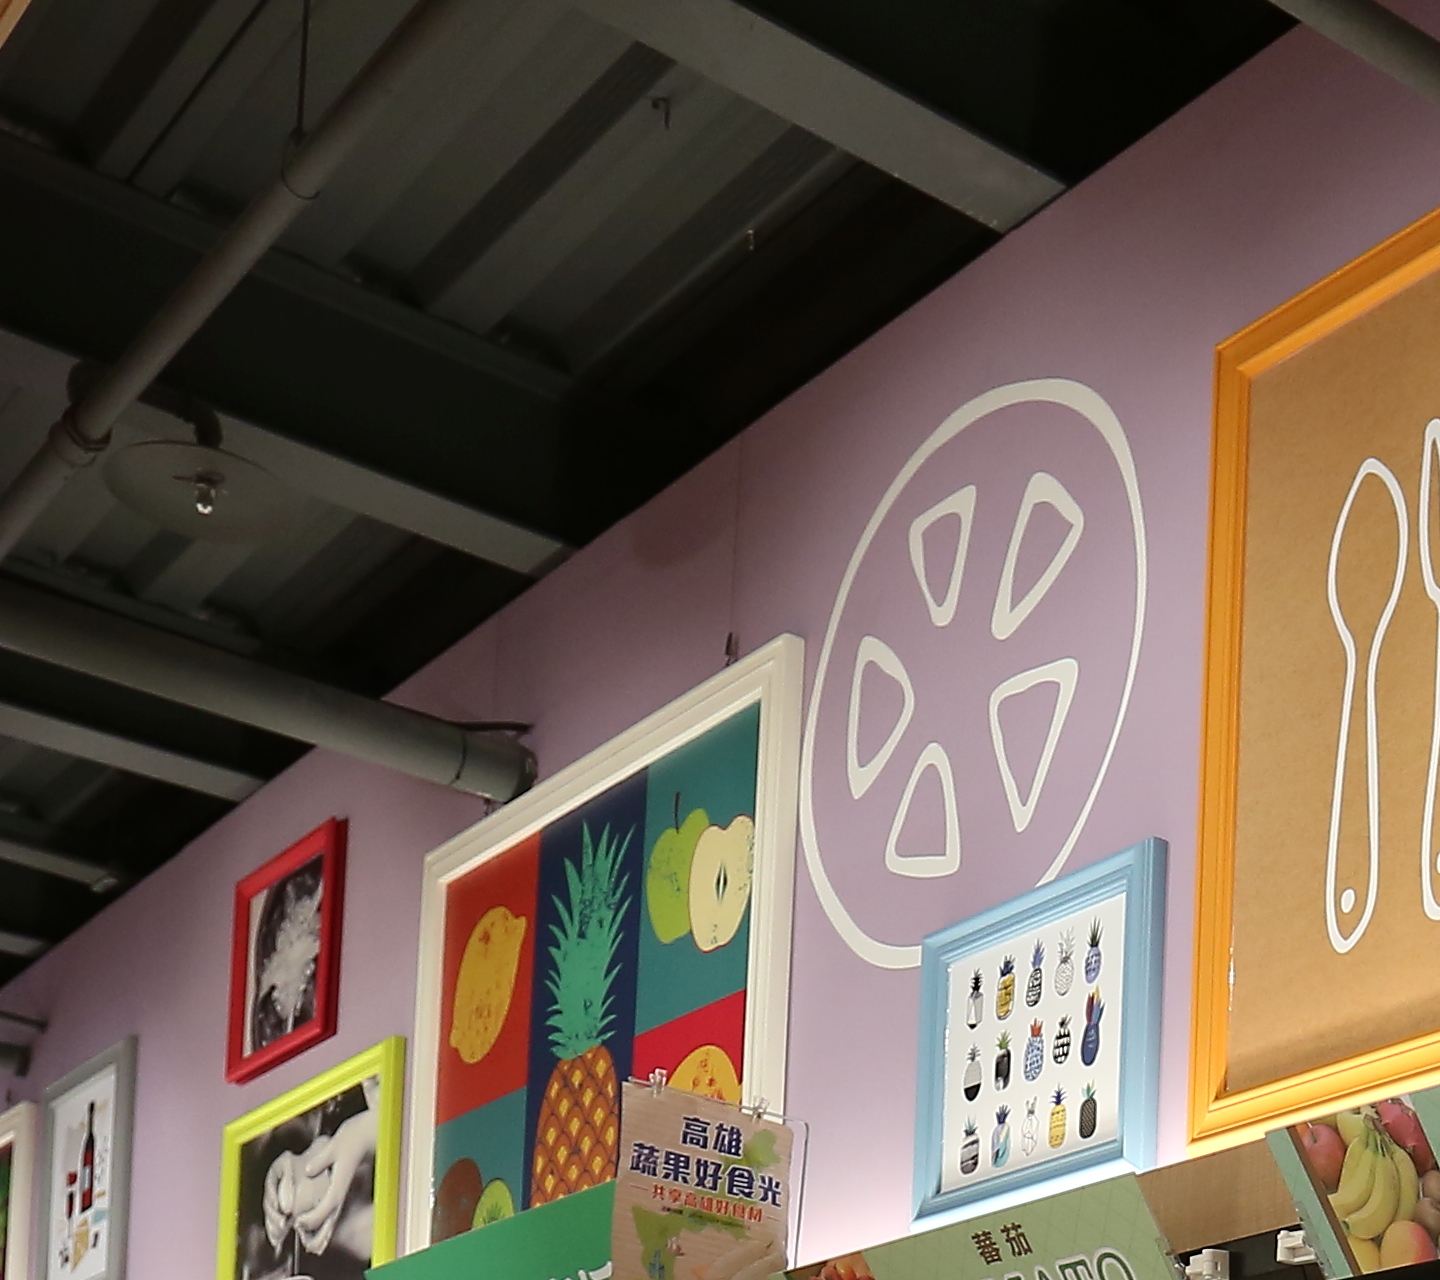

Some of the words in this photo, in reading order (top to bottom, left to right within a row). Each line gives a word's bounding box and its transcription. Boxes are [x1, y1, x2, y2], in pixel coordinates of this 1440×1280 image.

[681, 1116, 743, 1158] 高雄
[630, 1142, 784, 1208] 蔬果好食光
[974, 1225, 1034, 1266] 蕃茄
